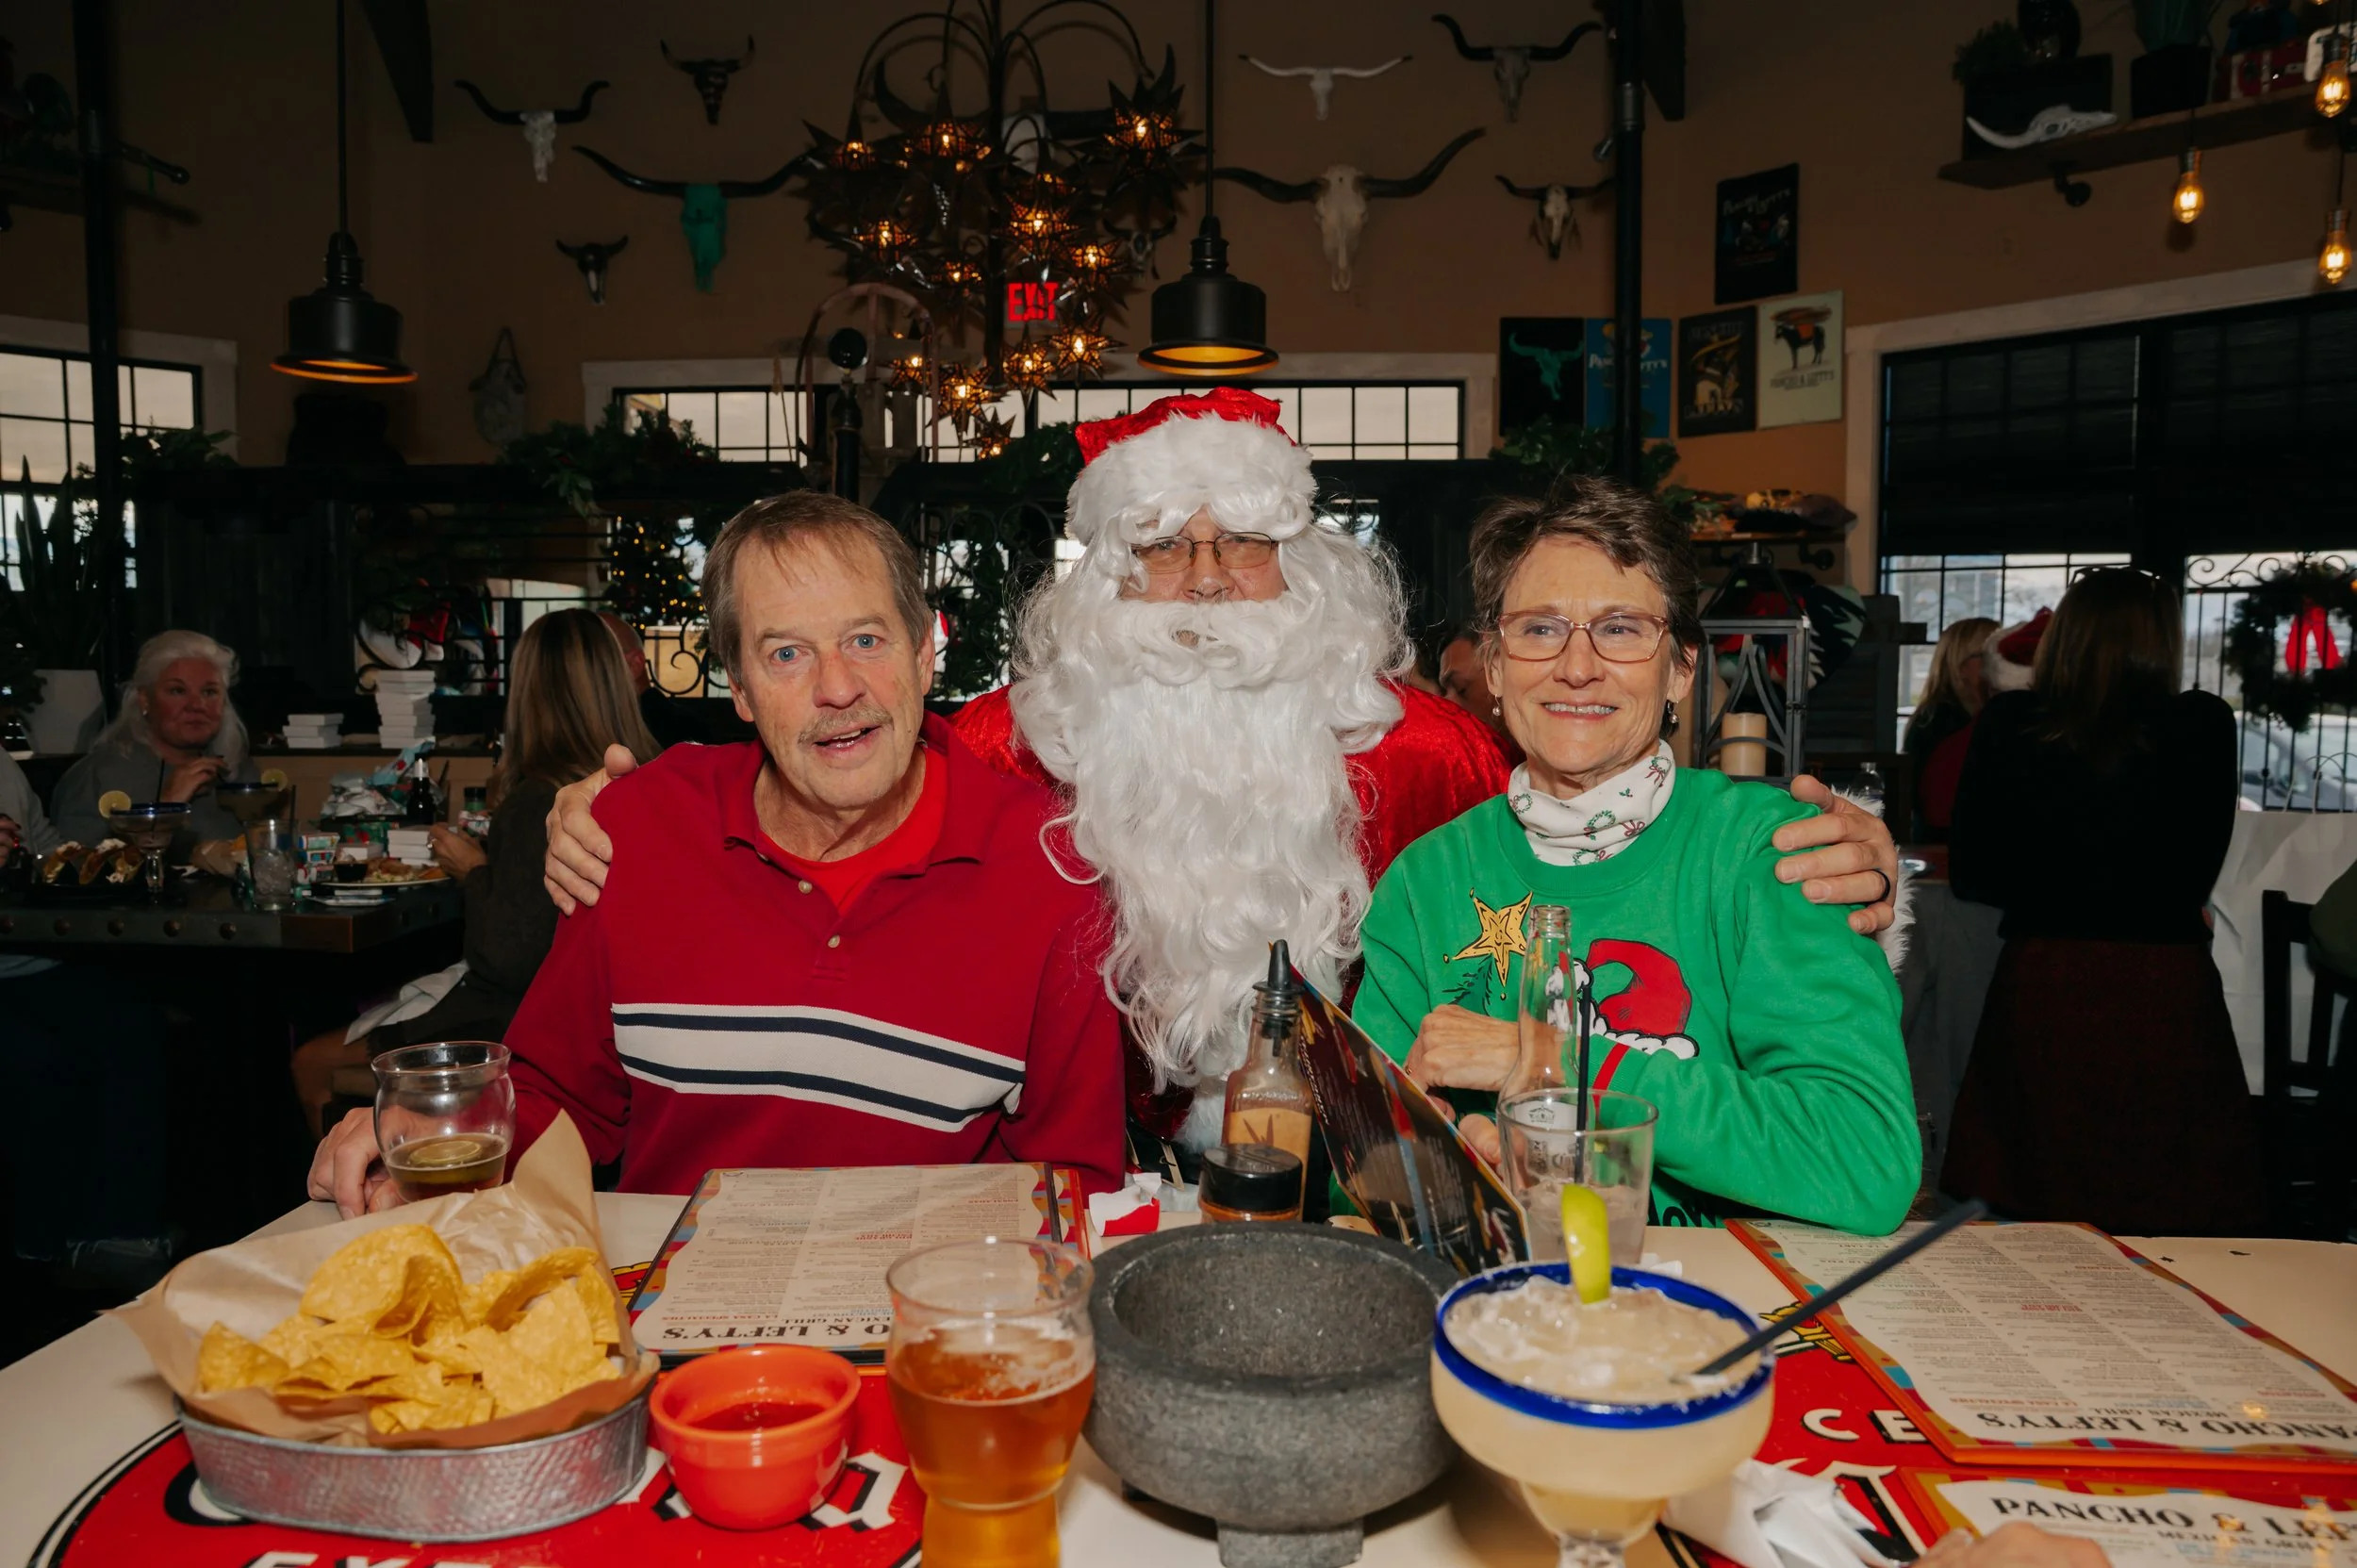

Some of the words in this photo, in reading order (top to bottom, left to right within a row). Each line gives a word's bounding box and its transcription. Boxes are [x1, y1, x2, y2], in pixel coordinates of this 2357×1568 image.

[1008, 282, 1059, 322] EXIT
[663, 1326, 808, 1340] LEFTY'S
[828, 1324, 849, 1336] &
[1977, 1411, 2148, 1432] LEFTY'S
[2157, 1418, 2191, 1433] &
[2200, 1420, 2357, 1440] ANCHO
[1990, 1497, 2195, 1527] PANCHO
[2211, 1513, 2254, 1533] &
